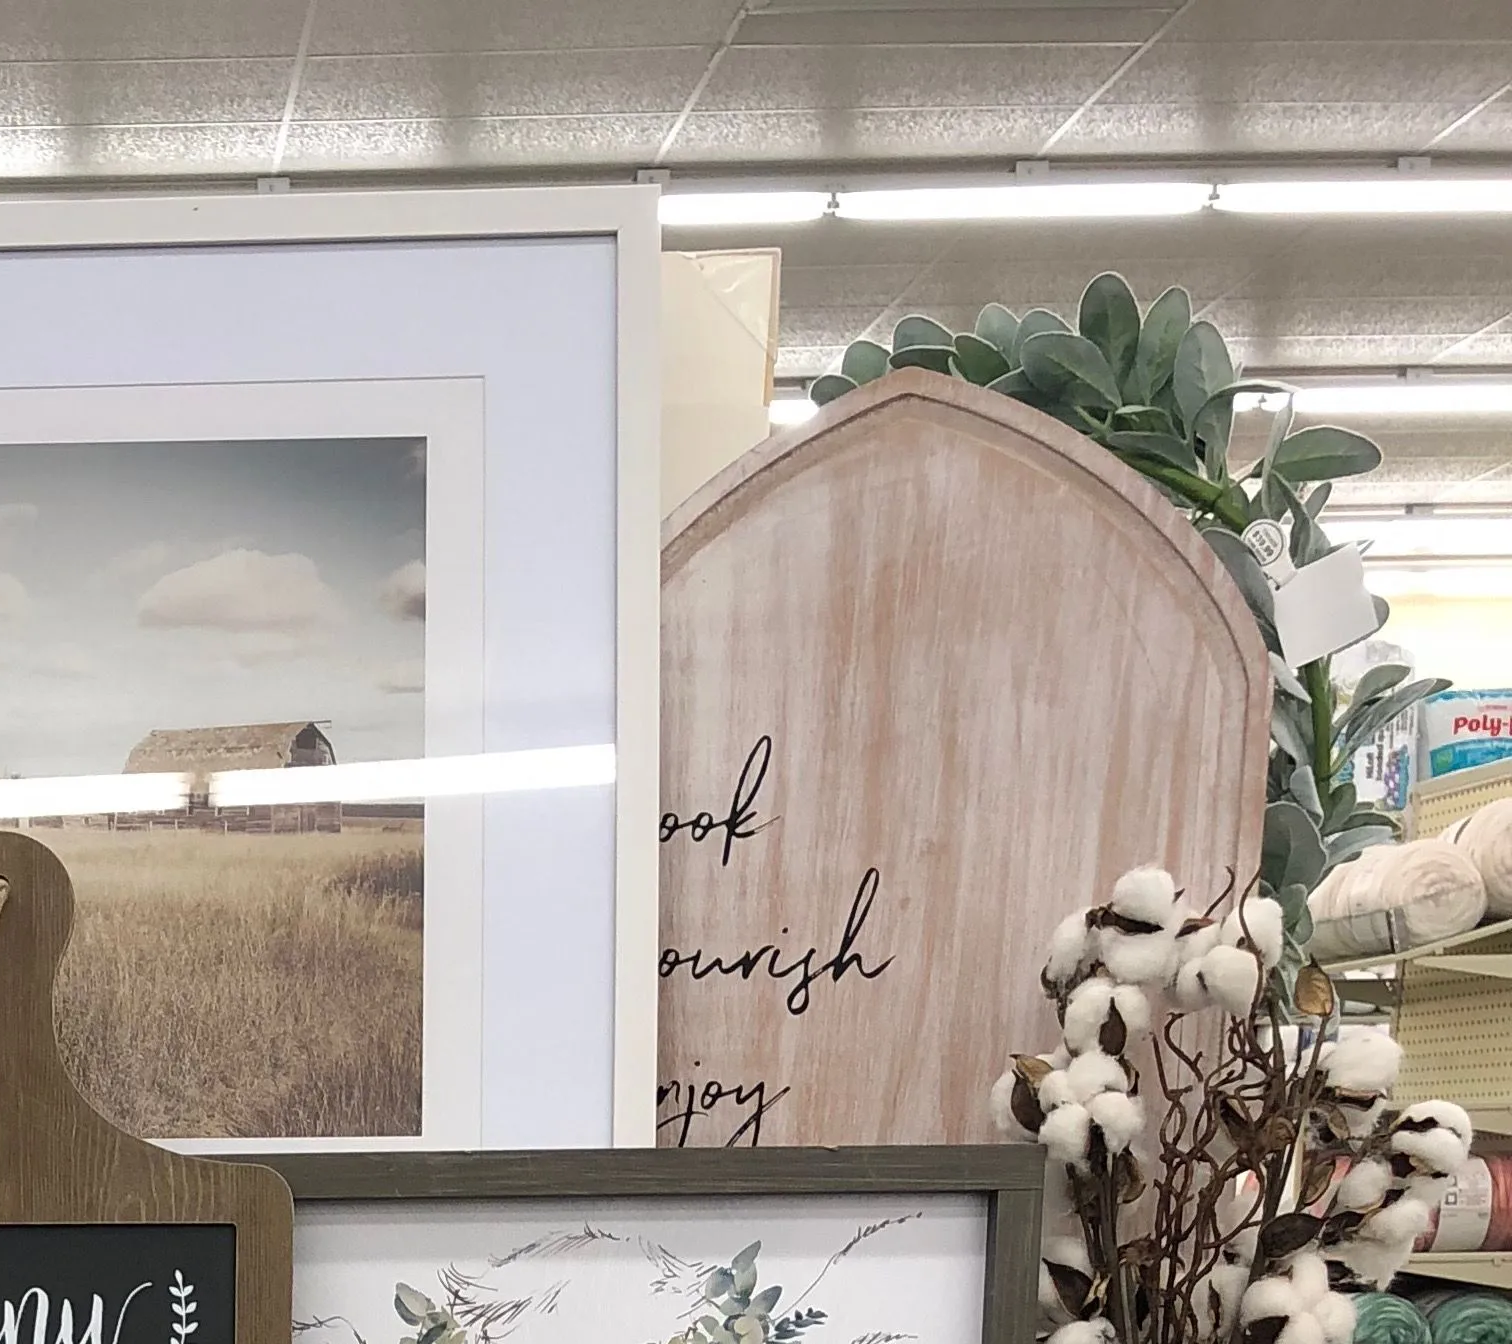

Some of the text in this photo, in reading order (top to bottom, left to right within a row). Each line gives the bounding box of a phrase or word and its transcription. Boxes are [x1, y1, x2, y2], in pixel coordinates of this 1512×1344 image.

[1453, 714, 1512, 736] Poly-
[659, 735, 781, 867] ook
[658, 867, 896, 1016] ourish
[656, 1060, 791, 1148] njoy
